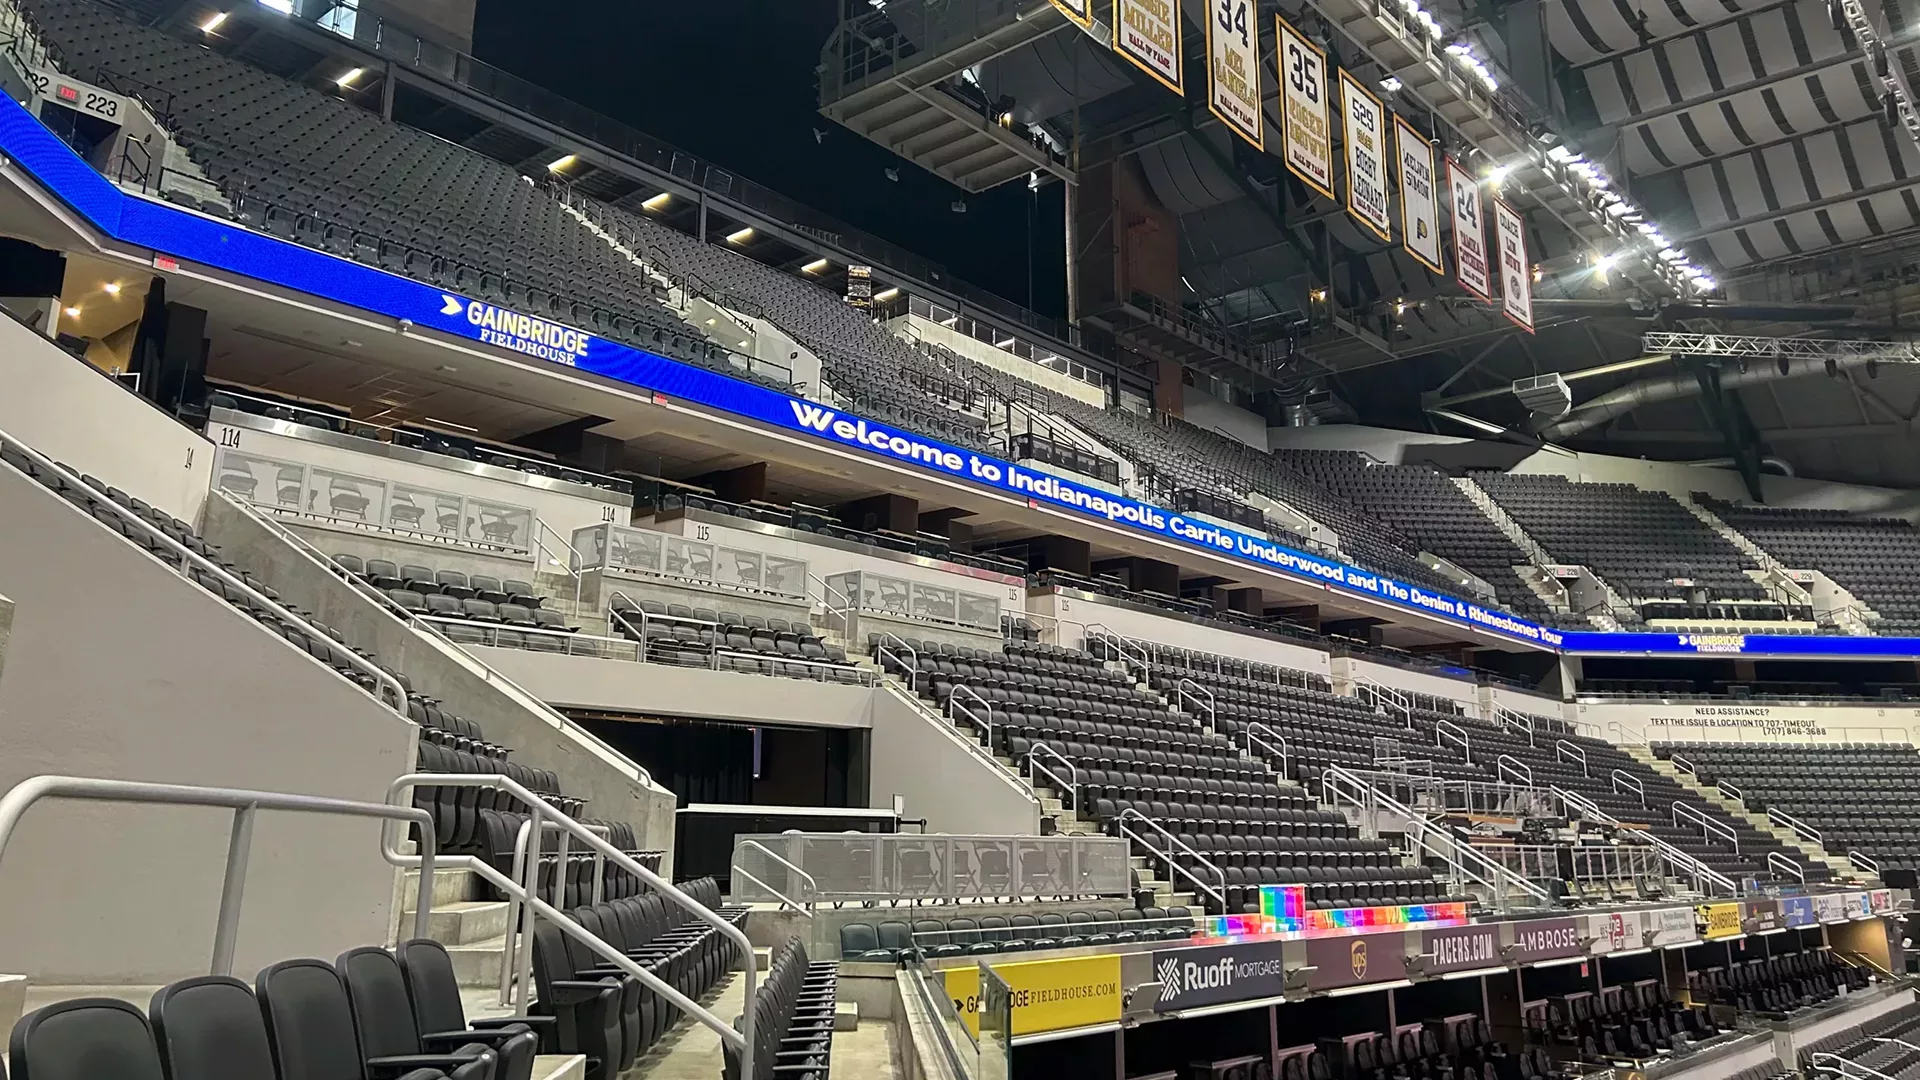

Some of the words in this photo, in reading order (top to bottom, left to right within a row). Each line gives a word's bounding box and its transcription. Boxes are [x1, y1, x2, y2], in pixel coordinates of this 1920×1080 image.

[1123, 1, 1173, 56] MILLER
[1218, 0, 1248, 48] 34
[1289, 43, 1318, 104] 35
[60, 86, 77, 100] EXIT
[85, 93, 118, 117] 223
[1288, 94, 1325, 140] ROGER
[1352, 97, 1374, 132] 529
[1289, 118, 1326, 163] BROWN
[1355, 146, 1377, 181] BOBBY
[1403, 148, 1430, 183] MELVIN
[1353, 171, 1383, 213] LEONARD
[1406, 171, 1429, 200] SIMON
[1456, 181, 1477, 229] 24
[1500, 213, 1519, 238] COACH
[467, 301, 590, 357] GAINBRIDGE
[480, 328, 576, 366] FIELDHOUSE
[220, 427, 240, 448] 114
[602, 506, 615, 522] 114
[789, 400, 963, 470] Welcome
[970, 454, 1001, 481] to
[1008, 467, 1165, 529] Indianapolis
[1170, 517, 1233, 549] Carrie
[1238, 536, 1344, 582] Underwood
[1348, 576, 1377, 592] and
[1380, 579, 1408, 600] The
[1411, 588, 1454, 613] Denim
[1456, 602, 1466, 617] &
[1469, 606, 1538, 638] Rhinestones
[1540, 628, 1563, 645] Tour
[697, 525, 709, 541] 115
[1689, 635, 1745, 648] GAINBRIDGE
[1651, 718, 1669, 726] TEXT
[1670, 718, 1685, 726] THE
[1686, 718, 1709, 726] ISSUE
[1717, 719, 1753, 727] LOCATION
[1717, 708, 1769, 716] ASSISTANCE?
[1787, 727, 1826, 735] 846-3688
[1432, 934, 1493, 965] PACERS.COM
[1519, 928, 1575, 952] AMBROSE
[1184, 957, 1233, 990] Ruoff
[1234, 960, 1280, 979] MORTGAGE
[1353, 952, 1367, 973] ups
[1031, 983, 1116, 1004] FIELDHOUSE.COM
